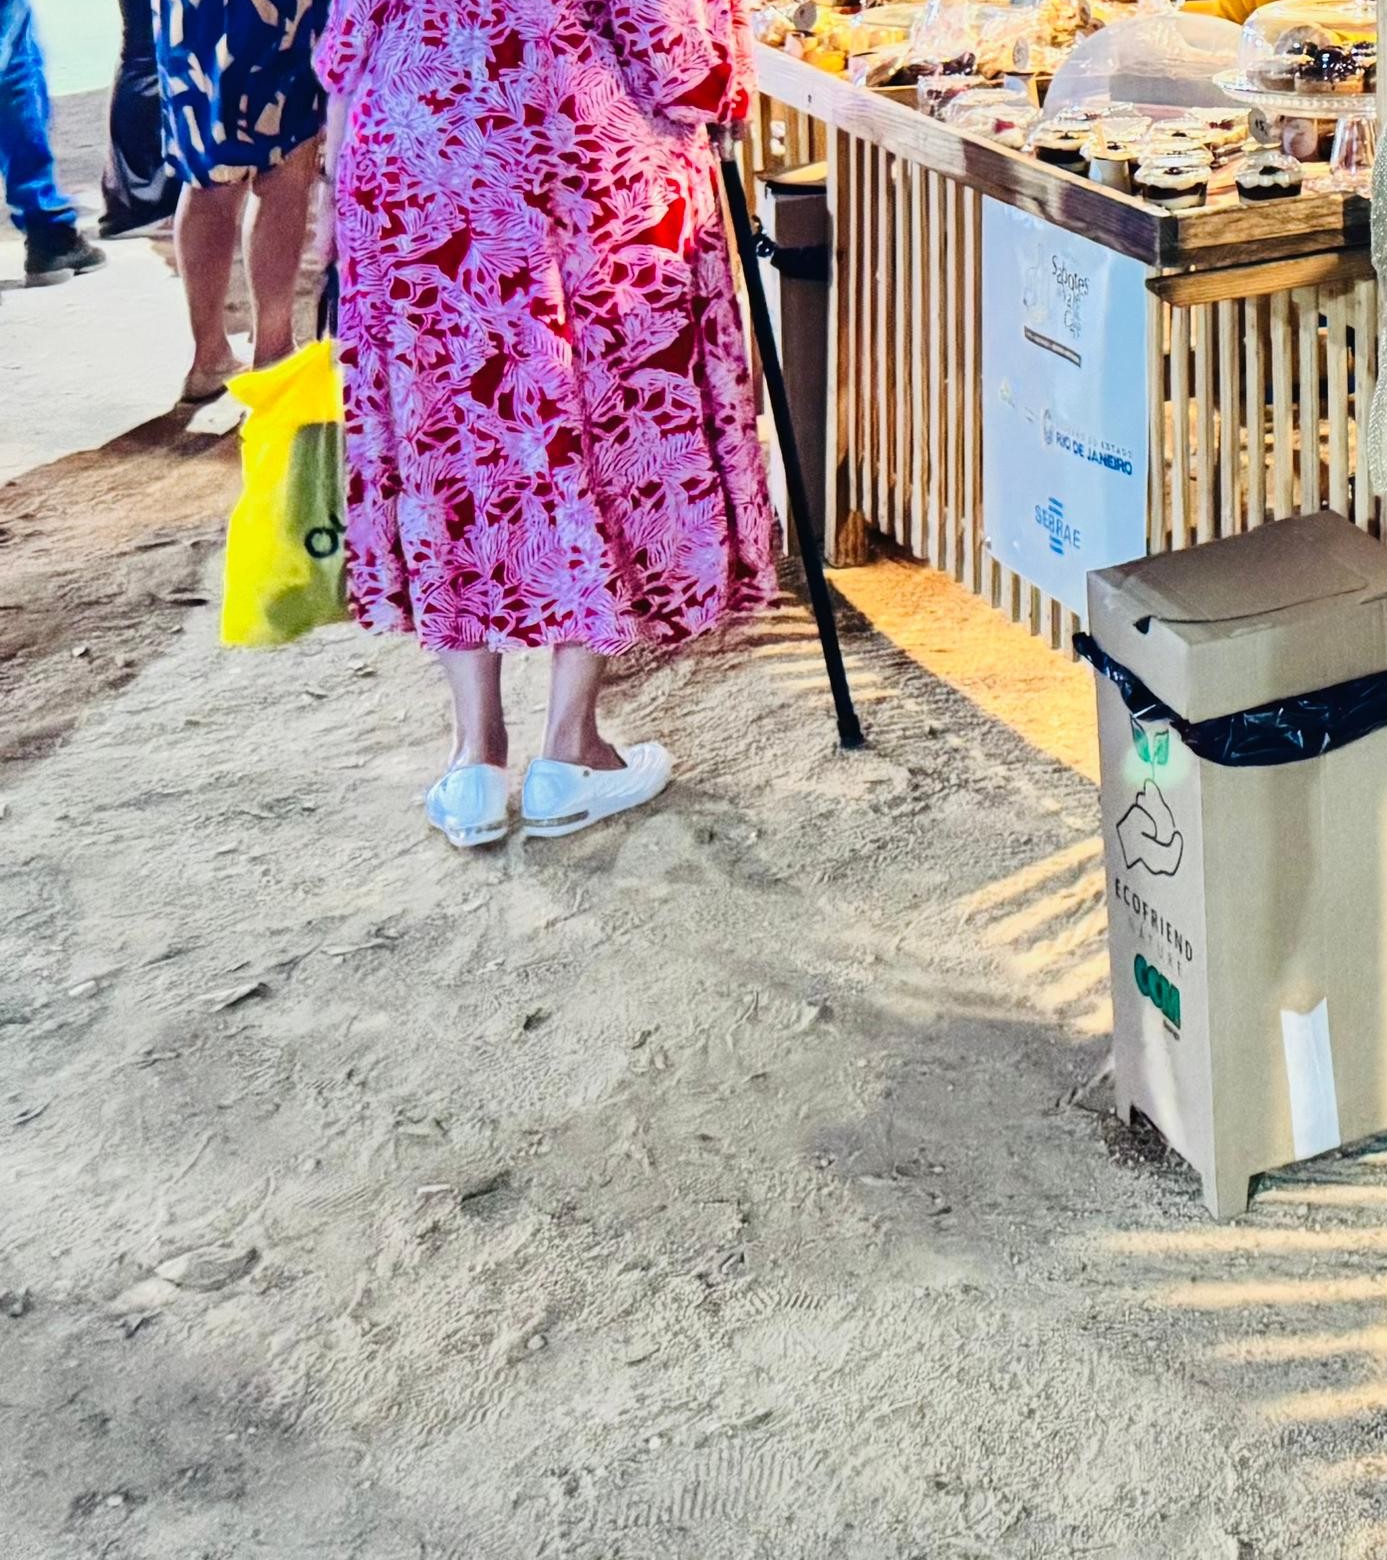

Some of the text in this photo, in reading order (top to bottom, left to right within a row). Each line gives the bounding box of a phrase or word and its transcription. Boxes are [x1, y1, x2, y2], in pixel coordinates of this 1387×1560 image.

[1056, 431, 1071, 452] RIO
[1073, 440, 1085, 458] DE
[1087, 447, 1133, 476] JANEIRO
[1034, 504, 1081, 550] SEBRAE
[1114, 877, 1193, 962] ECOFRIEND
